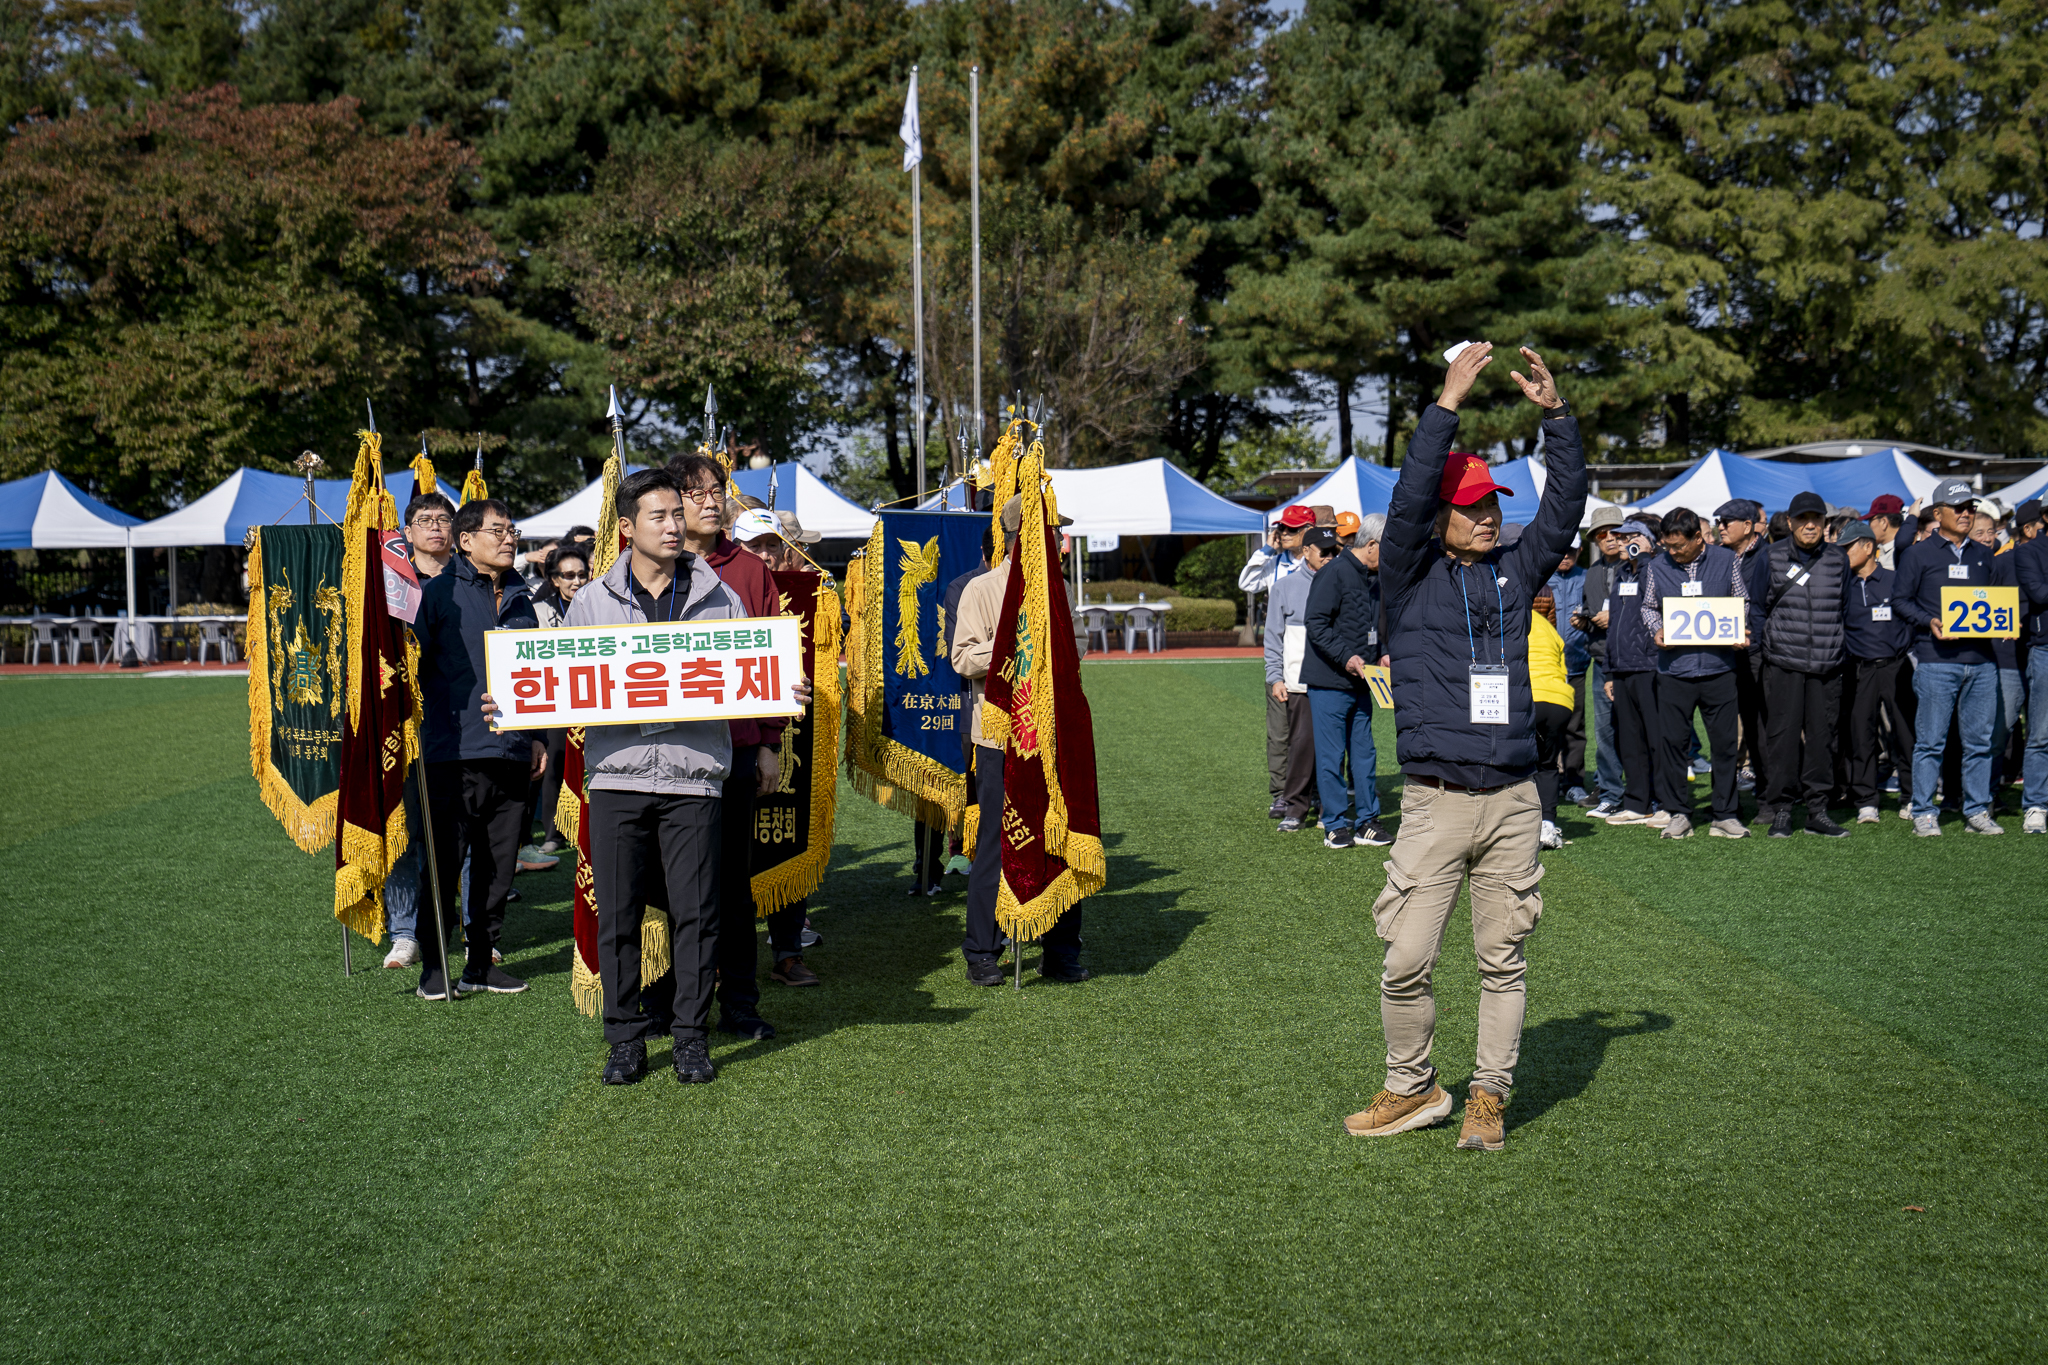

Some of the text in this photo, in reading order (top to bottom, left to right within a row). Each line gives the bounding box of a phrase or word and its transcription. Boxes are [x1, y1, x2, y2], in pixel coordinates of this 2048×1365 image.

[1670, 610, 1739, 640] 20회
[1948, 600, 2013, 633] 23회
[511, 656, 781, 714] 한마음축제
[920, 714, 954, 731] 29回
[754, 807, 796, 844] 동창회
